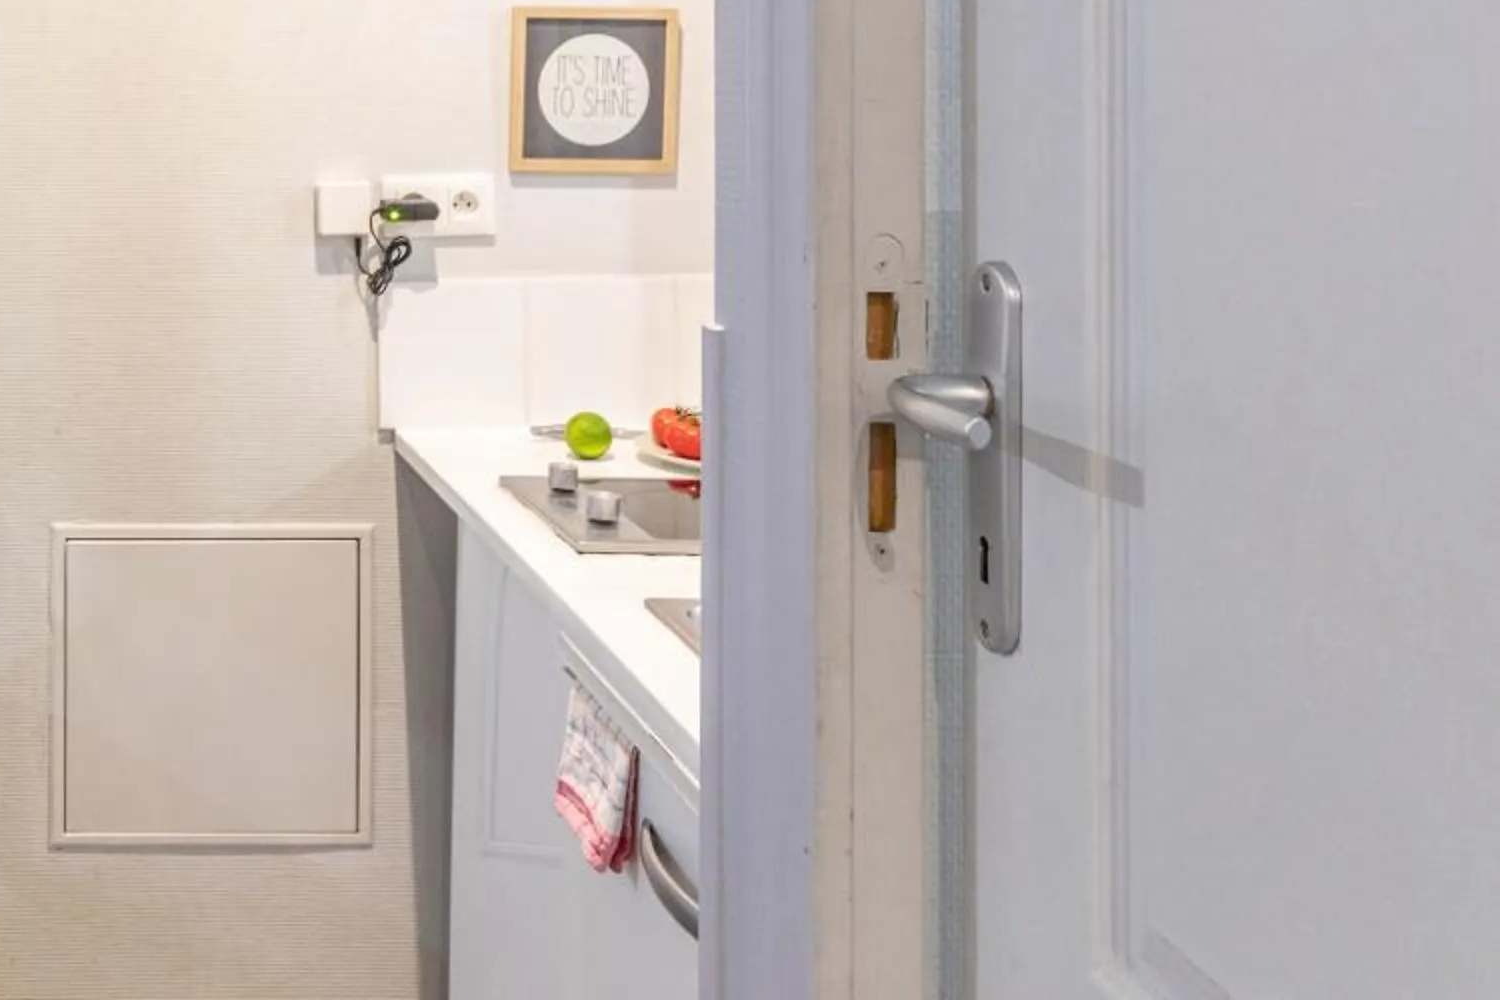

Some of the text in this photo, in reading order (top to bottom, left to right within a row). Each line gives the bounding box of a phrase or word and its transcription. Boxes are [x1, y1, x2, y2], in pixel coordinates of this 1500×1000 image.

[557, 55, 632, 87] IT'S TIME
[552, 86, 636, 119] TO SHINE
